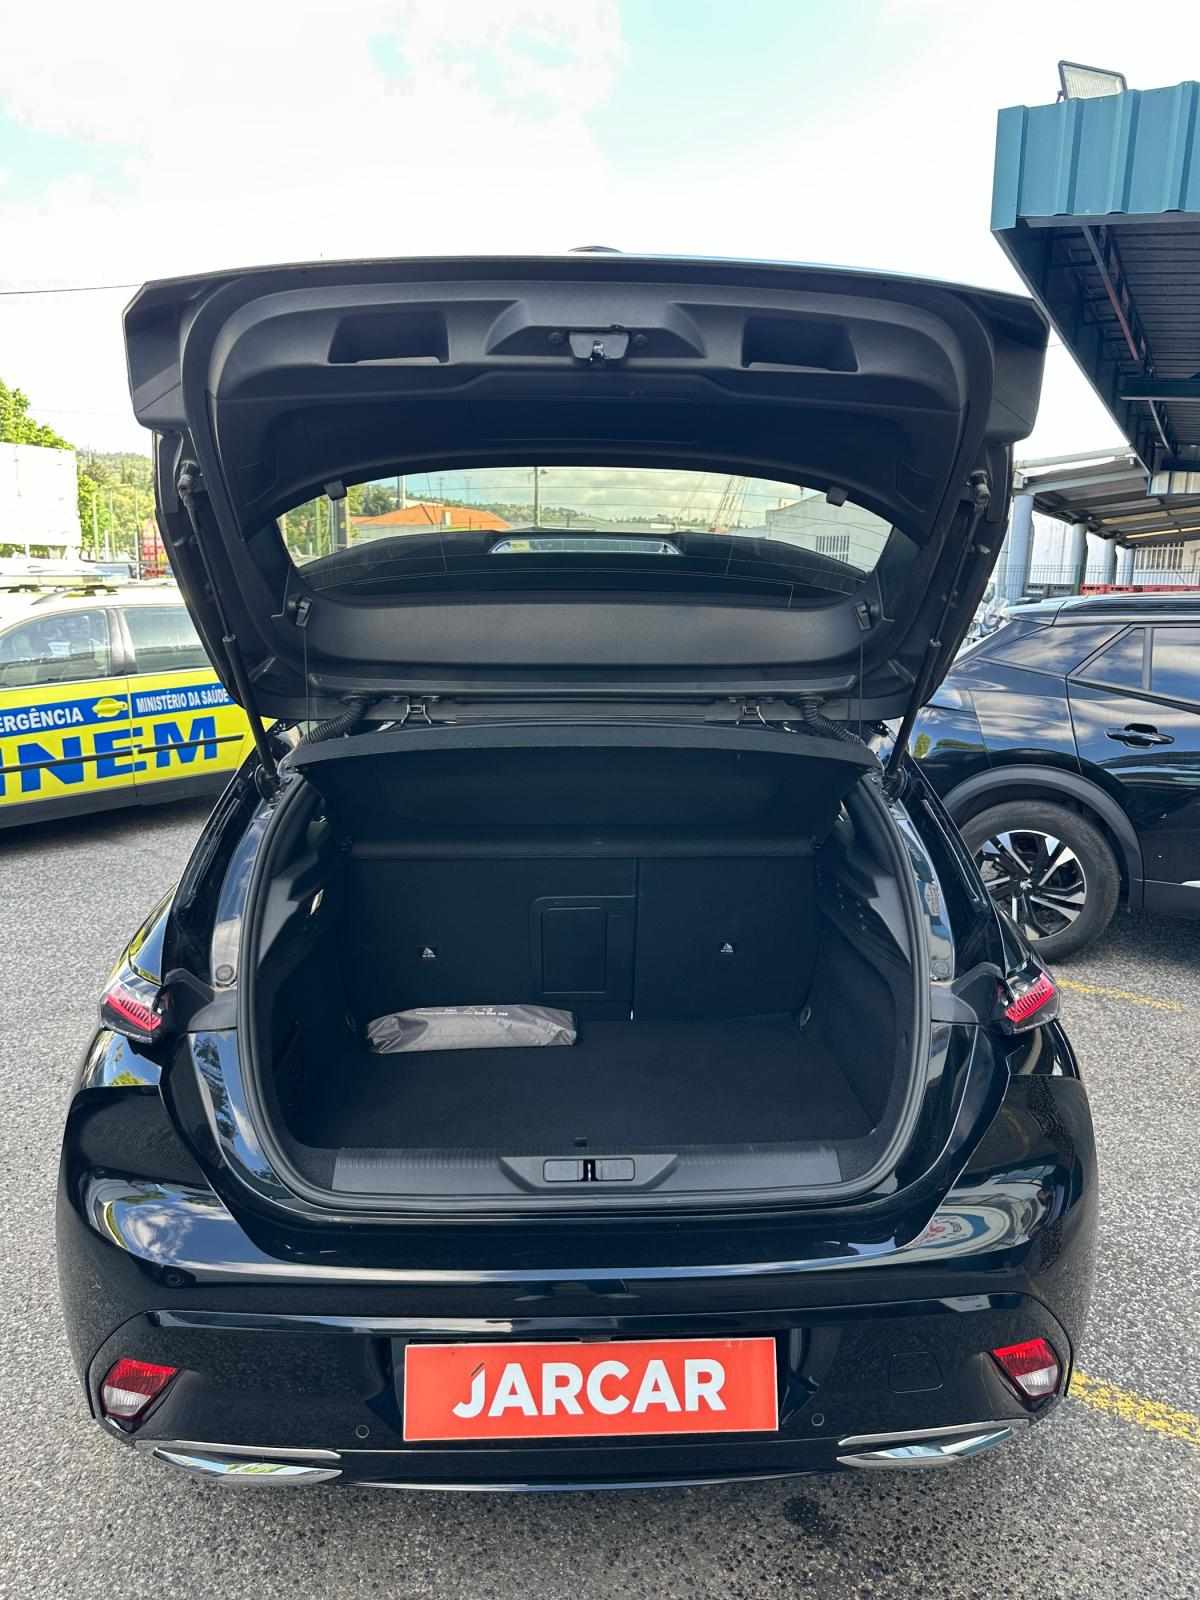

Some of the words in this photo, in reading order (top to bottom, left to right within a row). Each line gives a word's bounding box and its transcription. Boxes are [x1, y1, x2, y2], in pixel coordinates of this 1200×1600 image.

[136, 690, 187, 713] MINISTÉRIO
[187, 691, 201, 707] DA
[201, 685, 229, 705] SAÚDE
[0, 716, 217, 797] NEM
[452, 1358, 727, 1419] JARCAR
